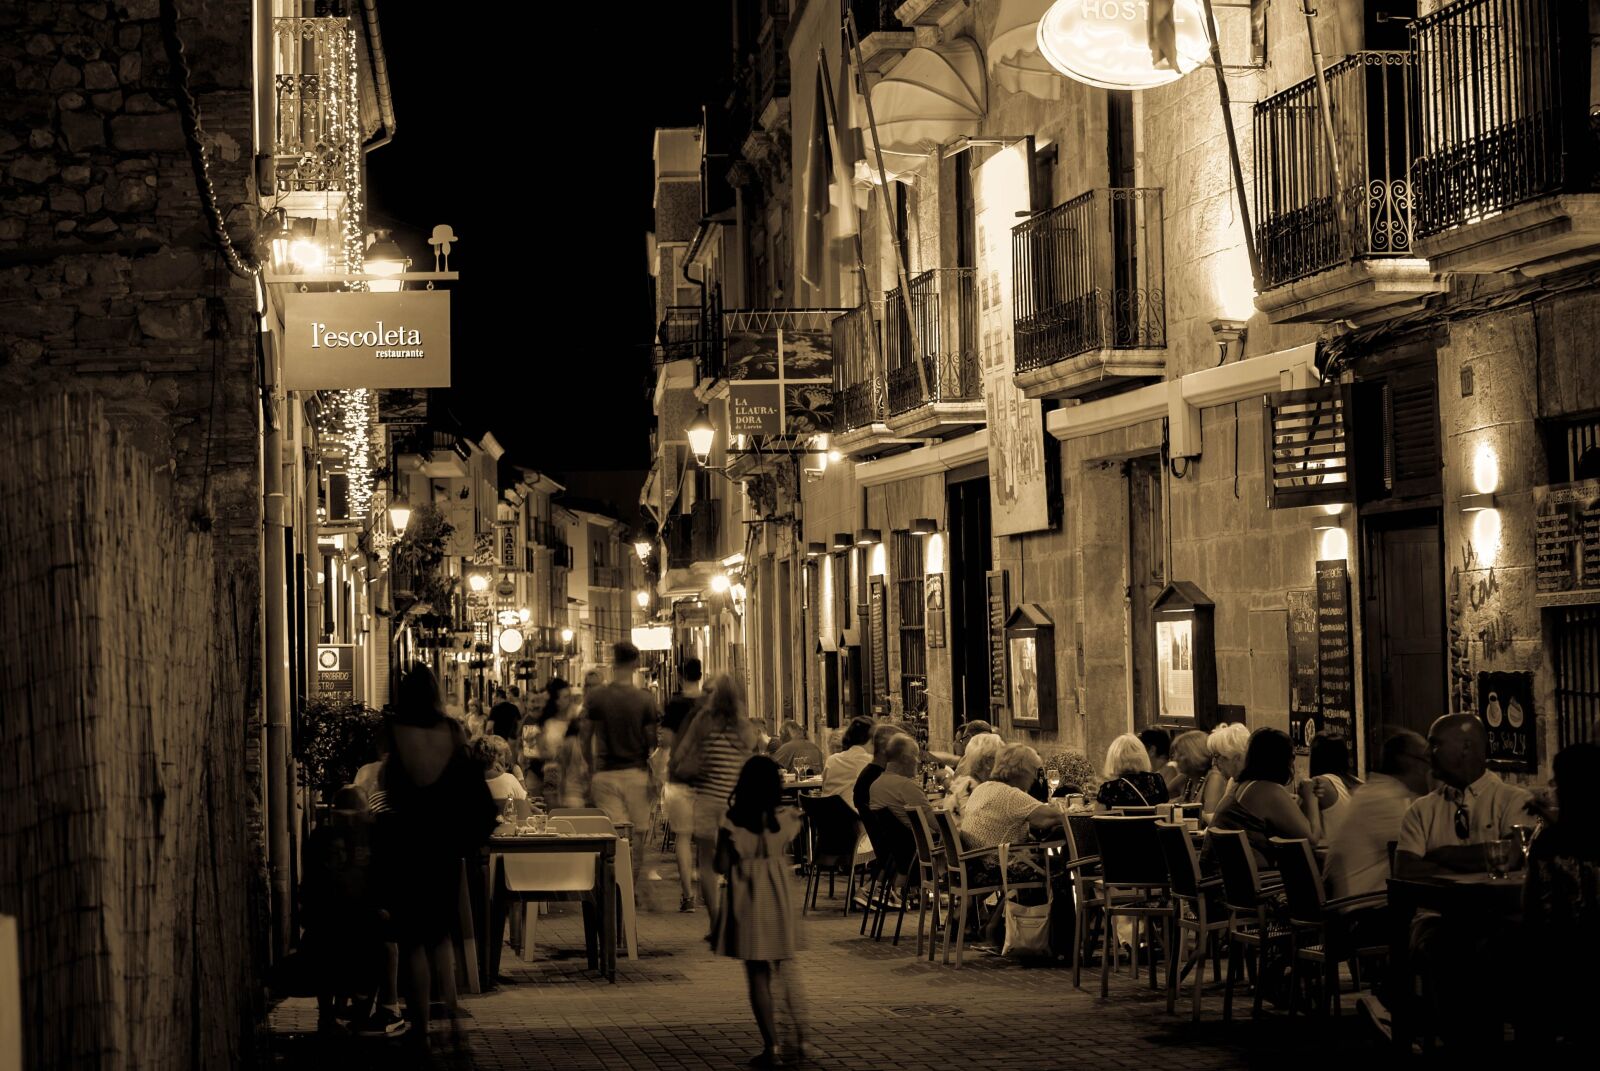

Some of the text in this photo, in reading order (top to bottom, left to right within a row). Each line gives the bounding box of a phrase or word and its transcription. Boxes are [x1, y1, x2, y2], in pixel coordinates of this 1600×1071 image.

[1081, 0, 1185, 22] HOSTL
[311, 321, 422, 348] l'escoleta
[376, 349, 424, 358] restaurante
[735, 398, 748, 406] LA
[735, 406, 778, 415] LLAURA-
[735, 416, 762, 424] DORA
[505, 526, 514, 567] TABACOS
